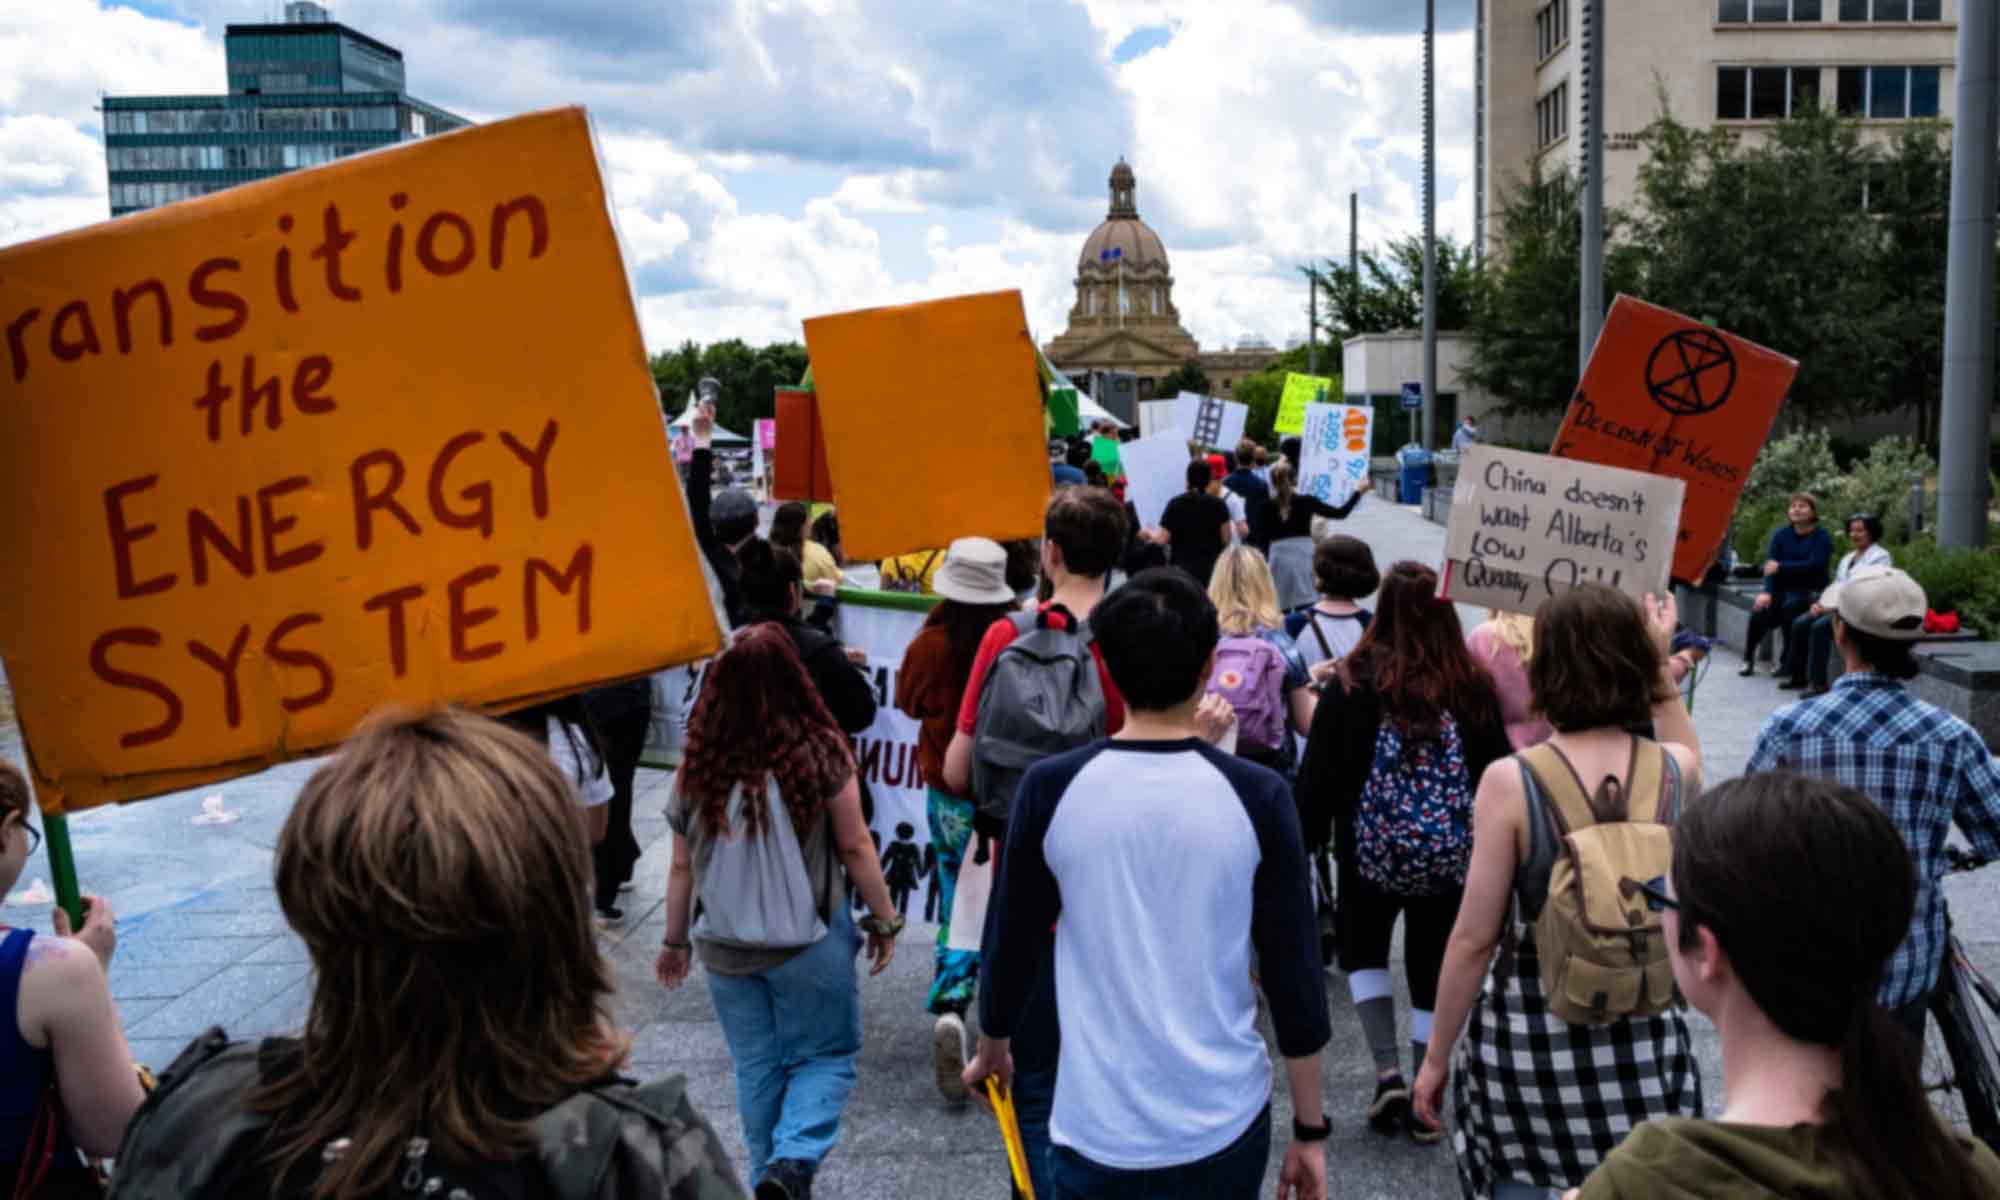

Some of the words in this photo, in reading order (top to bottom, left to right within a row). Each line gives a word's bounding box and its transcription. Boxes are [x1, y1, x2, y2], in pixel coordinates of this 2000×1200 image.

[4, 192, 550, 384] ransition
[195, 354, 337, 442] the
[104, 420, 560, 600] ENERGY
[1484, 460, 1547, 496] China
[1564, 478, 1645, 514] doesn't
[1545, 509, 1649, 562] Alberta's
[90, 544, 594, 748] SYSTEM
